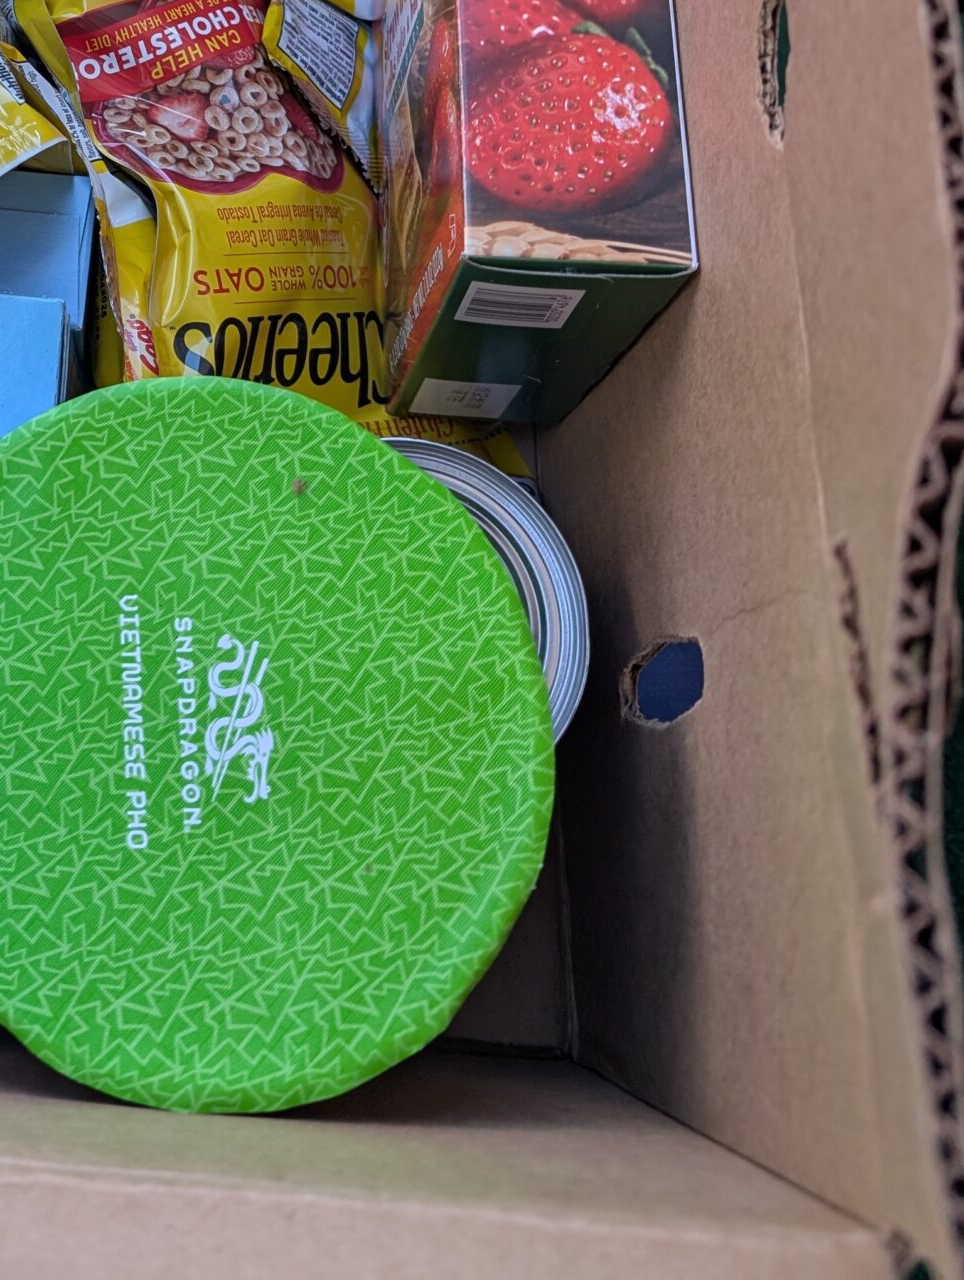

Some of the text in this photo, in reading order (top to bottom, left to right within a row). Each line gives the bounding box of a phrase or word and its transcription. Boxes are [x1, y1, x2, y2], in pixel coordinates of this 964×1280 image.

[164, 2, 198, 23] HEART
[196, 0, 205, 11] A
[115, 15, 164, 45] HEALTHY
[72, 6, 242, 81] CHOLESTERO
[86, 34, 113, 54] DIET
[151, 29, 242, 80] CAN HELP
[217, 201, 314, 224] Avena Integral Tostado
[226, 231, 258, 248] Cereal
[259, 229, 276, 248] Oat
[276, 227, 298, 248] Grain
[298, 228, 322, 248] Whole
[193, 266, 265, 296] OATS
[269, 265, 305, 278] GRAIN
[309, 264, 357, 290] 100%
[271, 279, 307, 291] WHOLE
[173, 616, 202, 826] SNAPDRAGON
[125, 790, 149, 850] PHO
